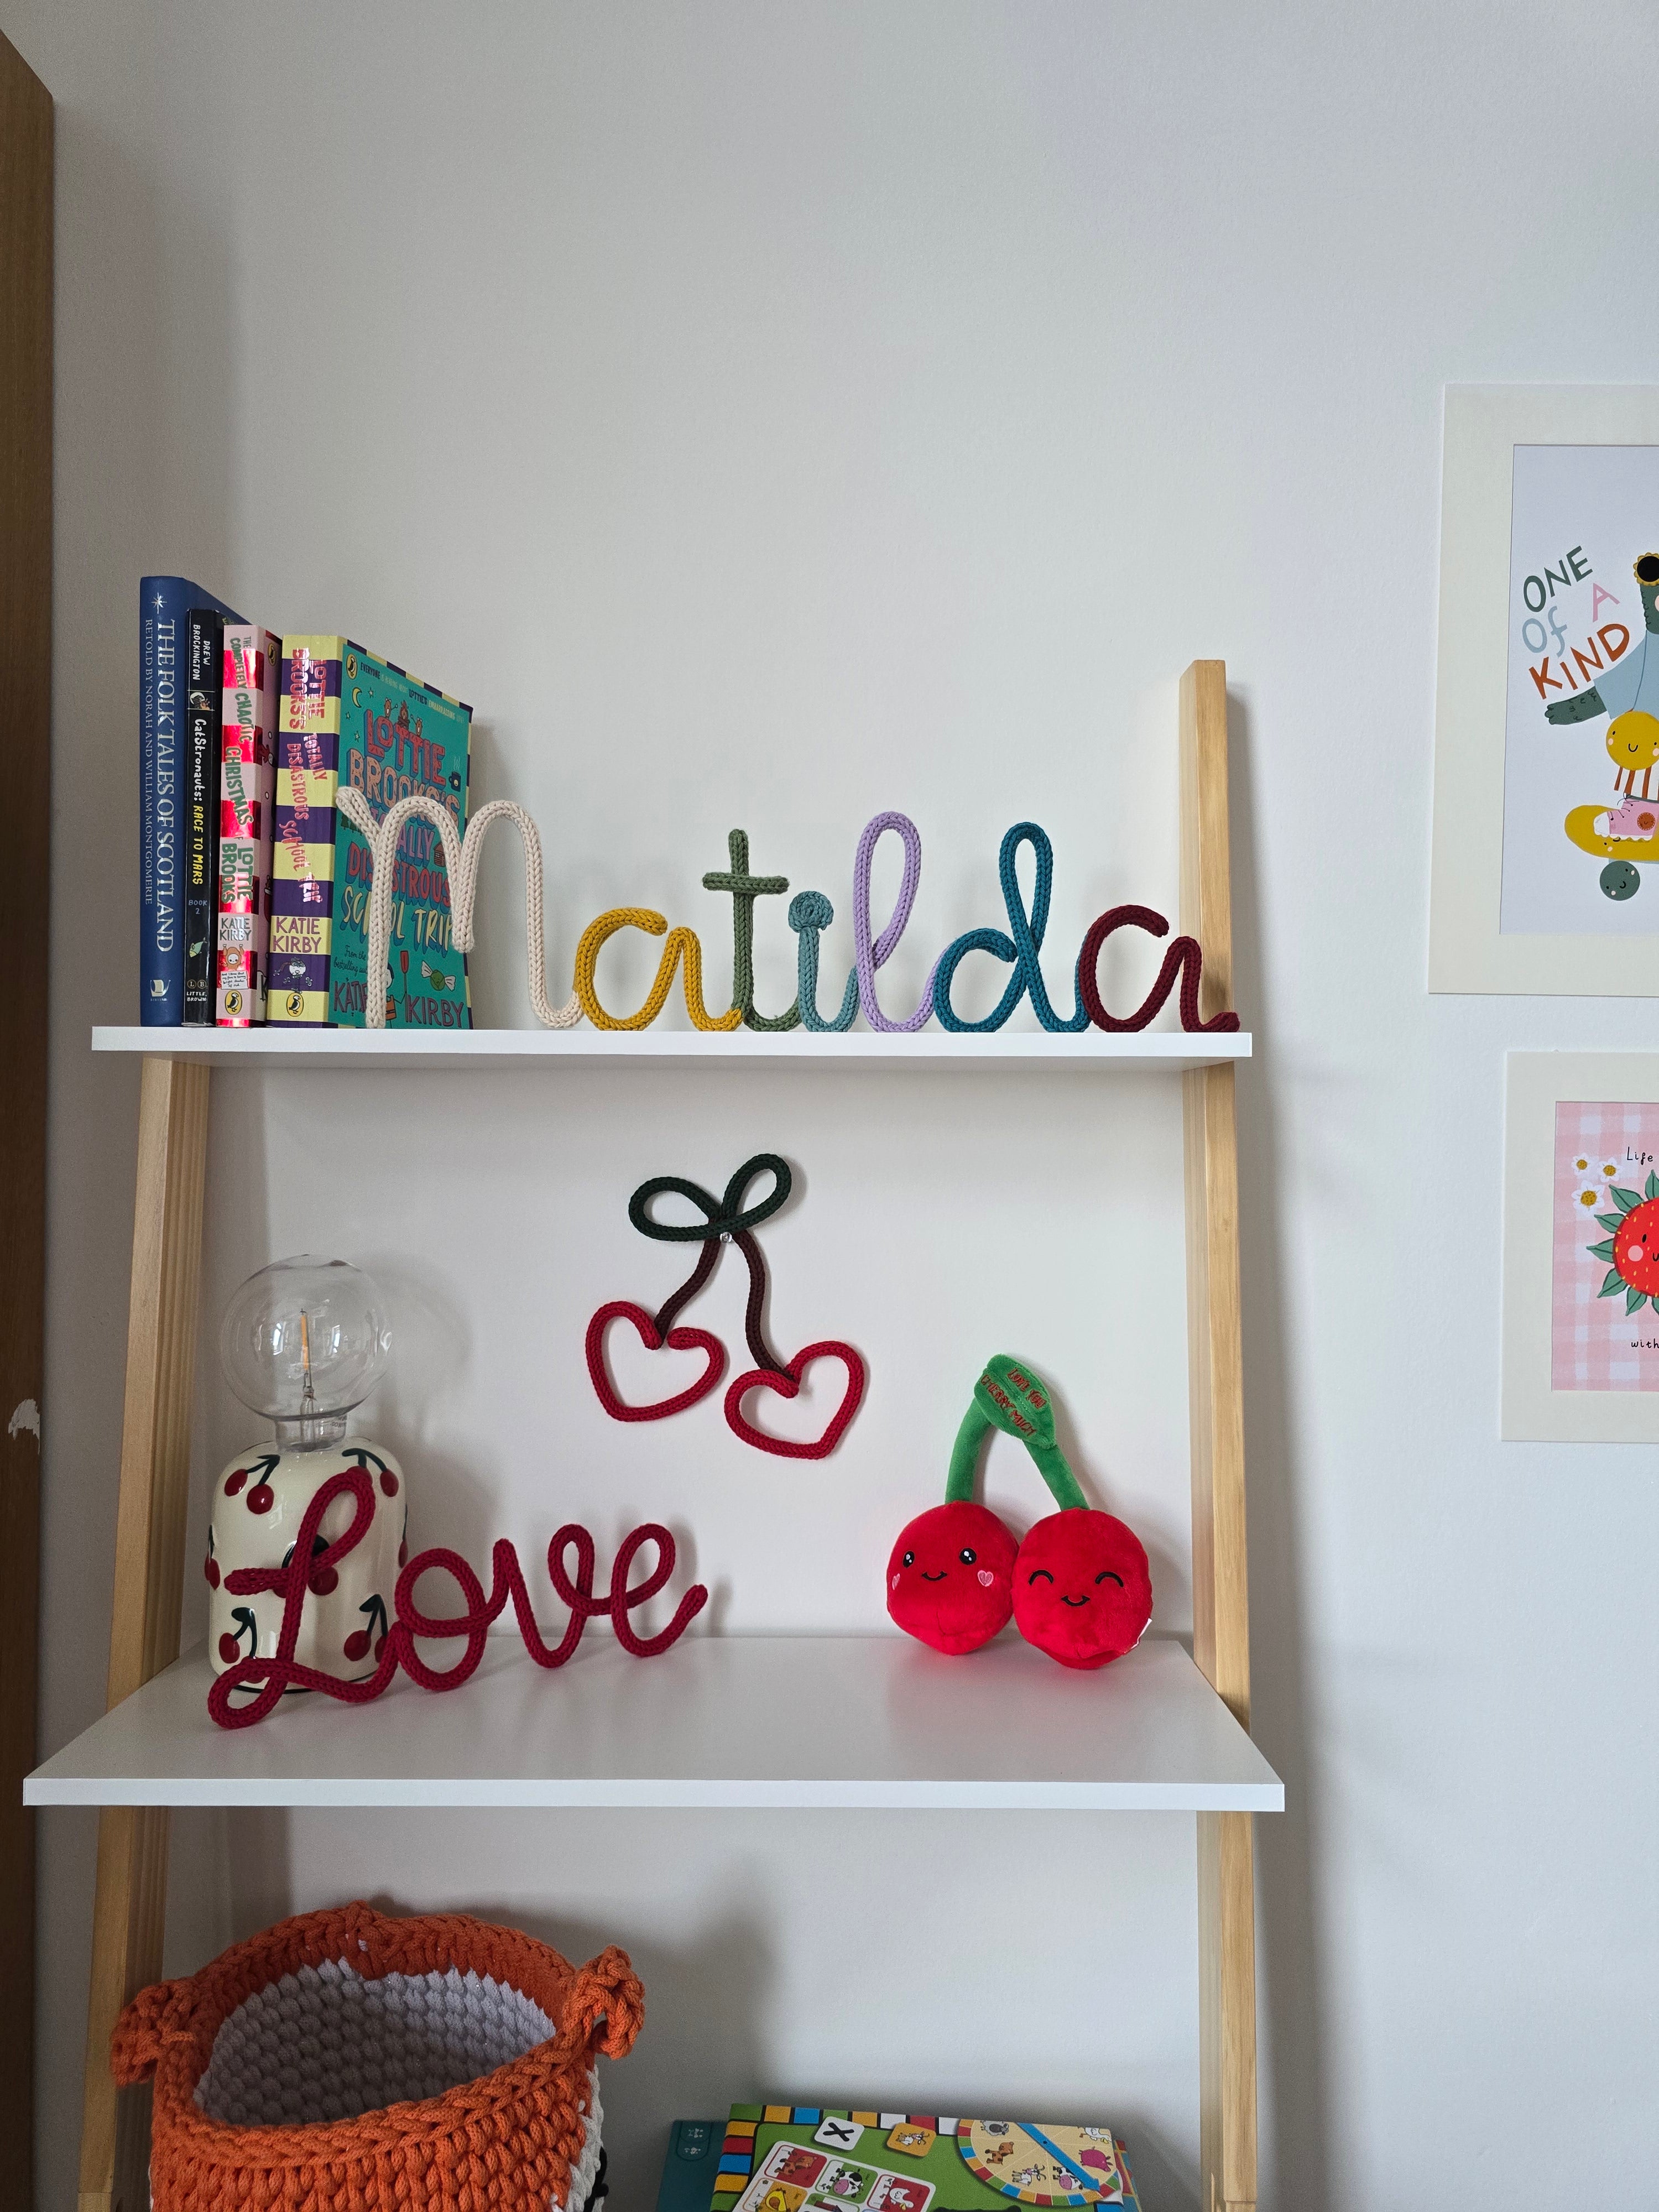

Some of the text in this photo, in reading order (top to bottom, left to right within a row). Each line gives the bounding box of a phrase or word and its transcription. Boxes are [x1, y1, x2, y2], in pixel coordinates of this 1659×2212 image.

[1524, 545, 1593, 612] ONE
[1593, 583, 1620, 623] A
[192, 624, 201, 680] BROCKINGTON
[230, 638, 247, 689] COMPLETELY
[243, 637, 252, 649] THE
[1528, 623, 1630, 700] KIND
[145, 669, 153, 682] BY
[309, 659, 327, 719] LOTTIE
[361, 662, 380, 679] EVERYONE
[234, 693, 255, 743] CHAOTIC
[304, 732, 327, 780] TOTALLY
[364, 709, 446, 785] LOTTIE
[156, 619, 175, 952] THE FOLK TALES OF SCOTLAND
[192, 719, 207, 885] CatStronauts: RACE TO MARS
[225, 747, 254, 826] CHRISTMAS
[287, 743, 309, 820] DISASTROUS
[279, 821, 311, 872] SCHOOL
[222, 843, 237, 904] BROOKS
[238, 847, 253, 901] LOTTIE
[348, 842, 451, 907] DISSTROUS
[220, 929, 252, 941] KIRBY
[221, 917, 251, 929] KATIE
[273, 935, 322, 953] KIRBY
[276, 917, 320, 935] KATIE
[408, 994, 464, 1028] KIRBY
[1627, 1146, 1653, 1166] Life
[1631, 1338, 1659, 1349] with
[981, 1374, 1037, 1436] CHERRY MUCH
[1007, 1367, 1047, 1408] LOVE YOU
[208, 1469, 708, 1729] Love
